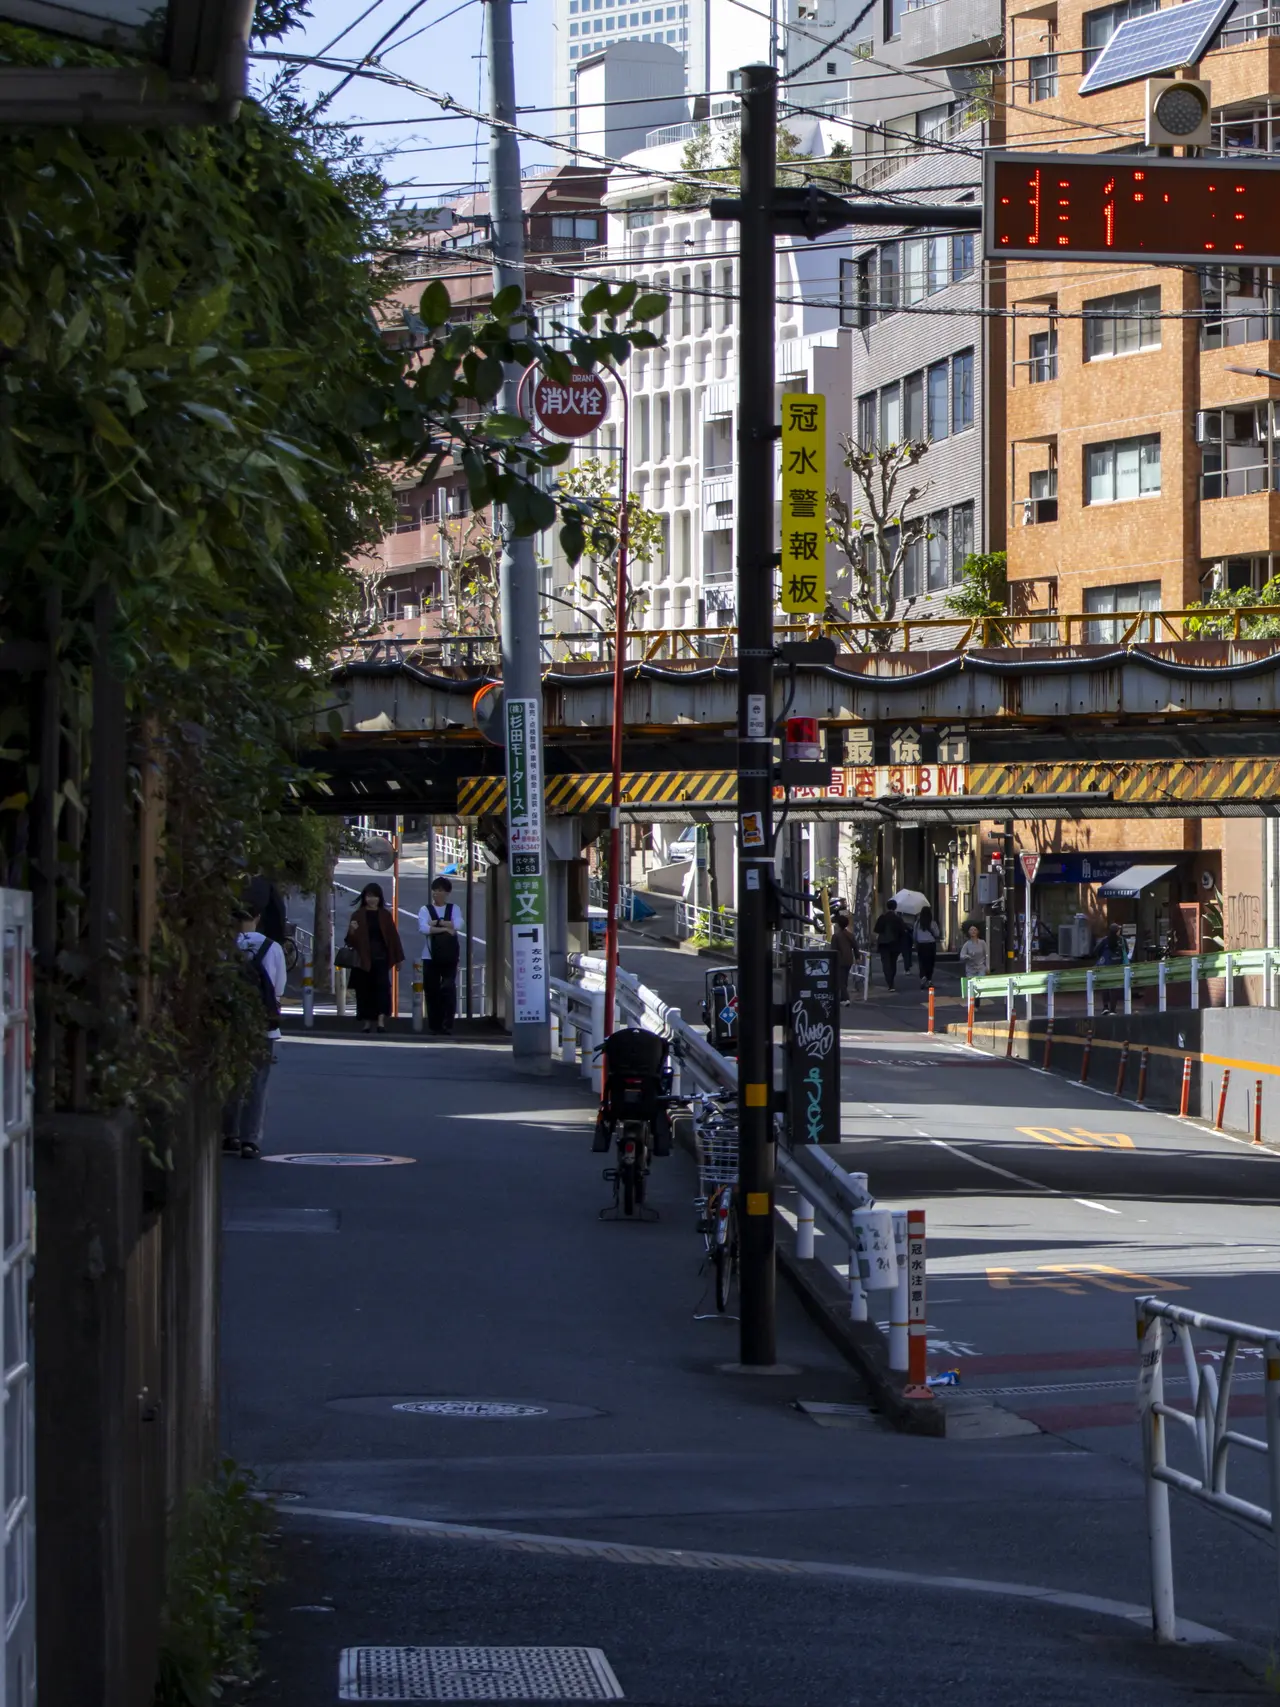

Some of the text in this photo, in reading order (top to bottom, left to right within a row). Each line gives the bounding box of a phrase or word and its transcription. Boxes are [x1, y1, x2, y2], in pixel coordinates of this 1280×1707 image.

[541, 387, 602, 415] 消火栓
[788, 403, 819, 603] 冠水警報板
[516, 865, 536, 873] 3-53
[531, 948, 543, 980] 左からの
